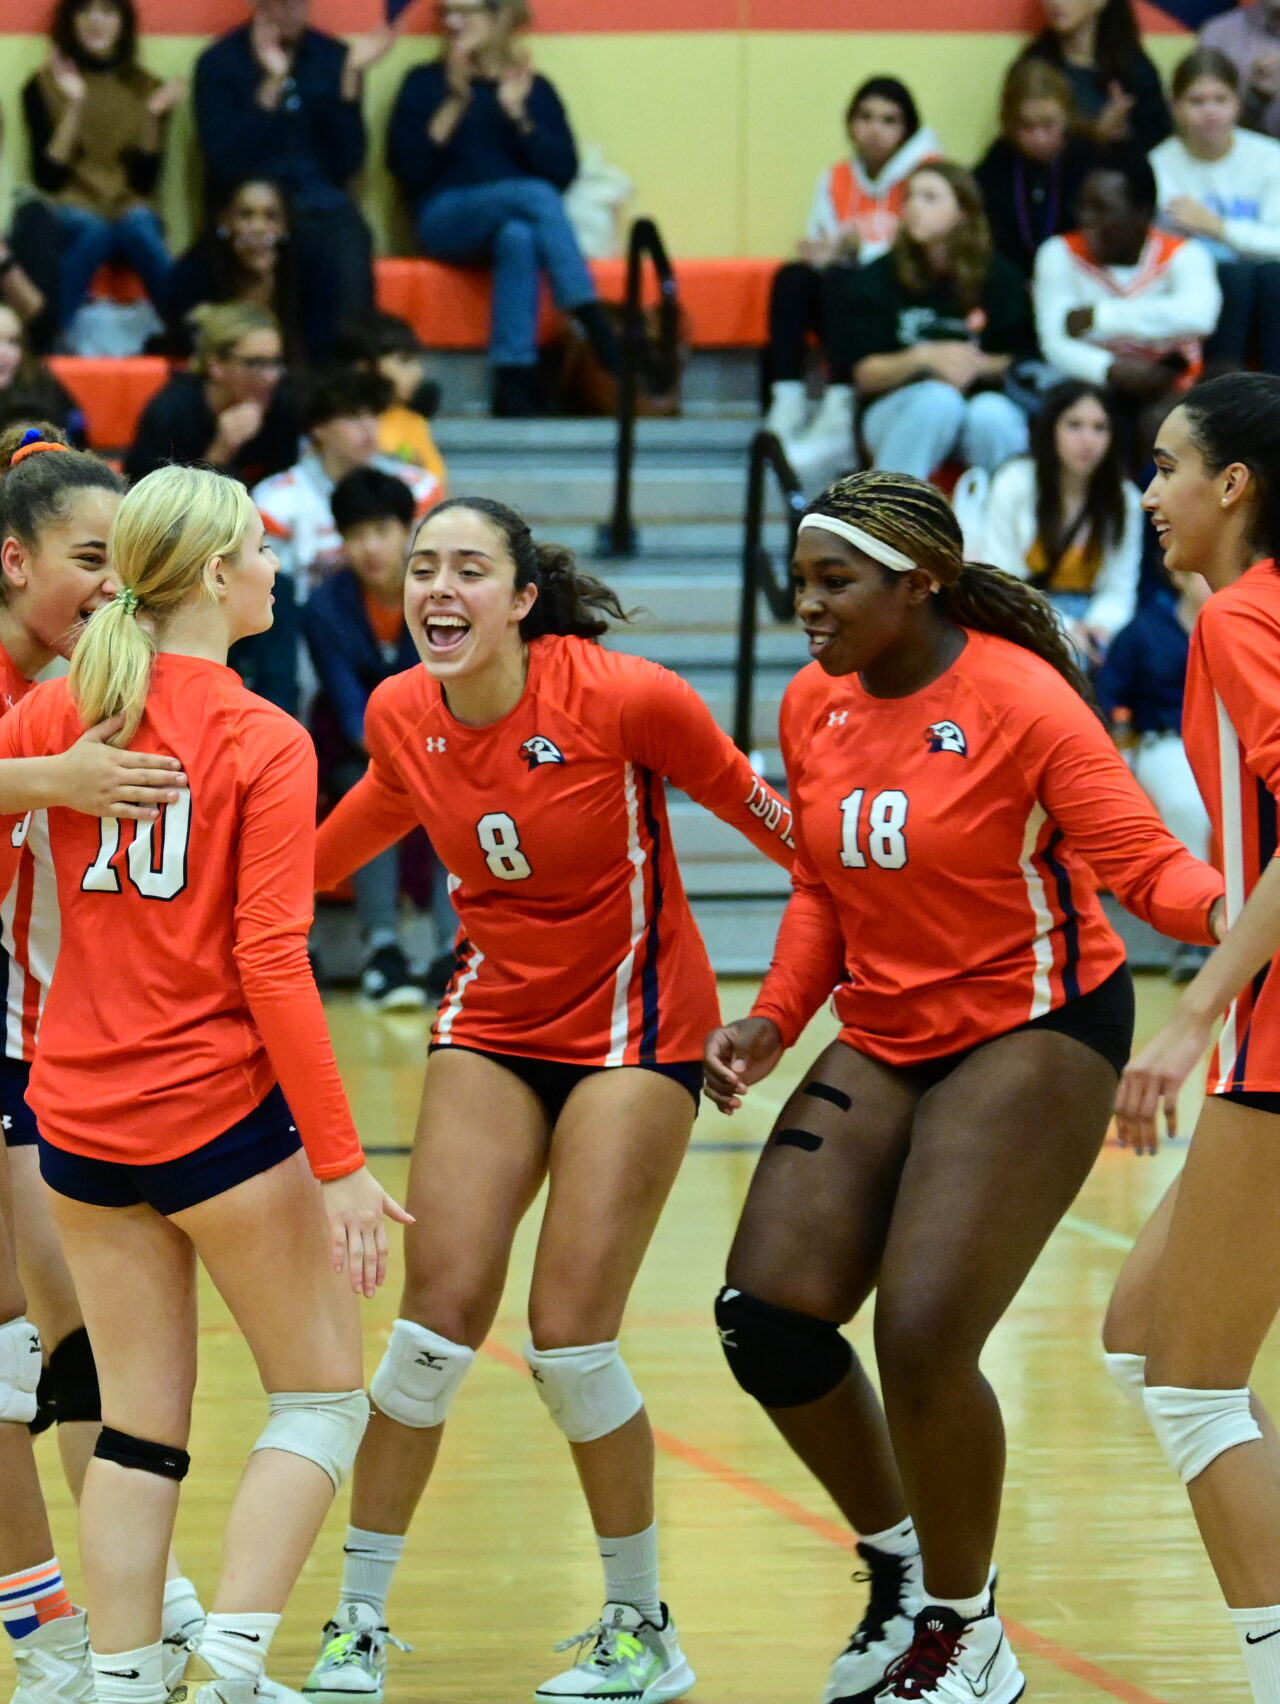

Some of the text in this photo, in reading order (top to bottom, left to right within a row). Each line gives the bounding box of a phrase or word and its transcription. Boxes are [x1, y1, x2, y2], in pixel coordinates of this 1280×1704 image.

[81, 783, 191, 902] 10
[475, 811, 533, 881] 8
[838, 787, 909, 871] 18
